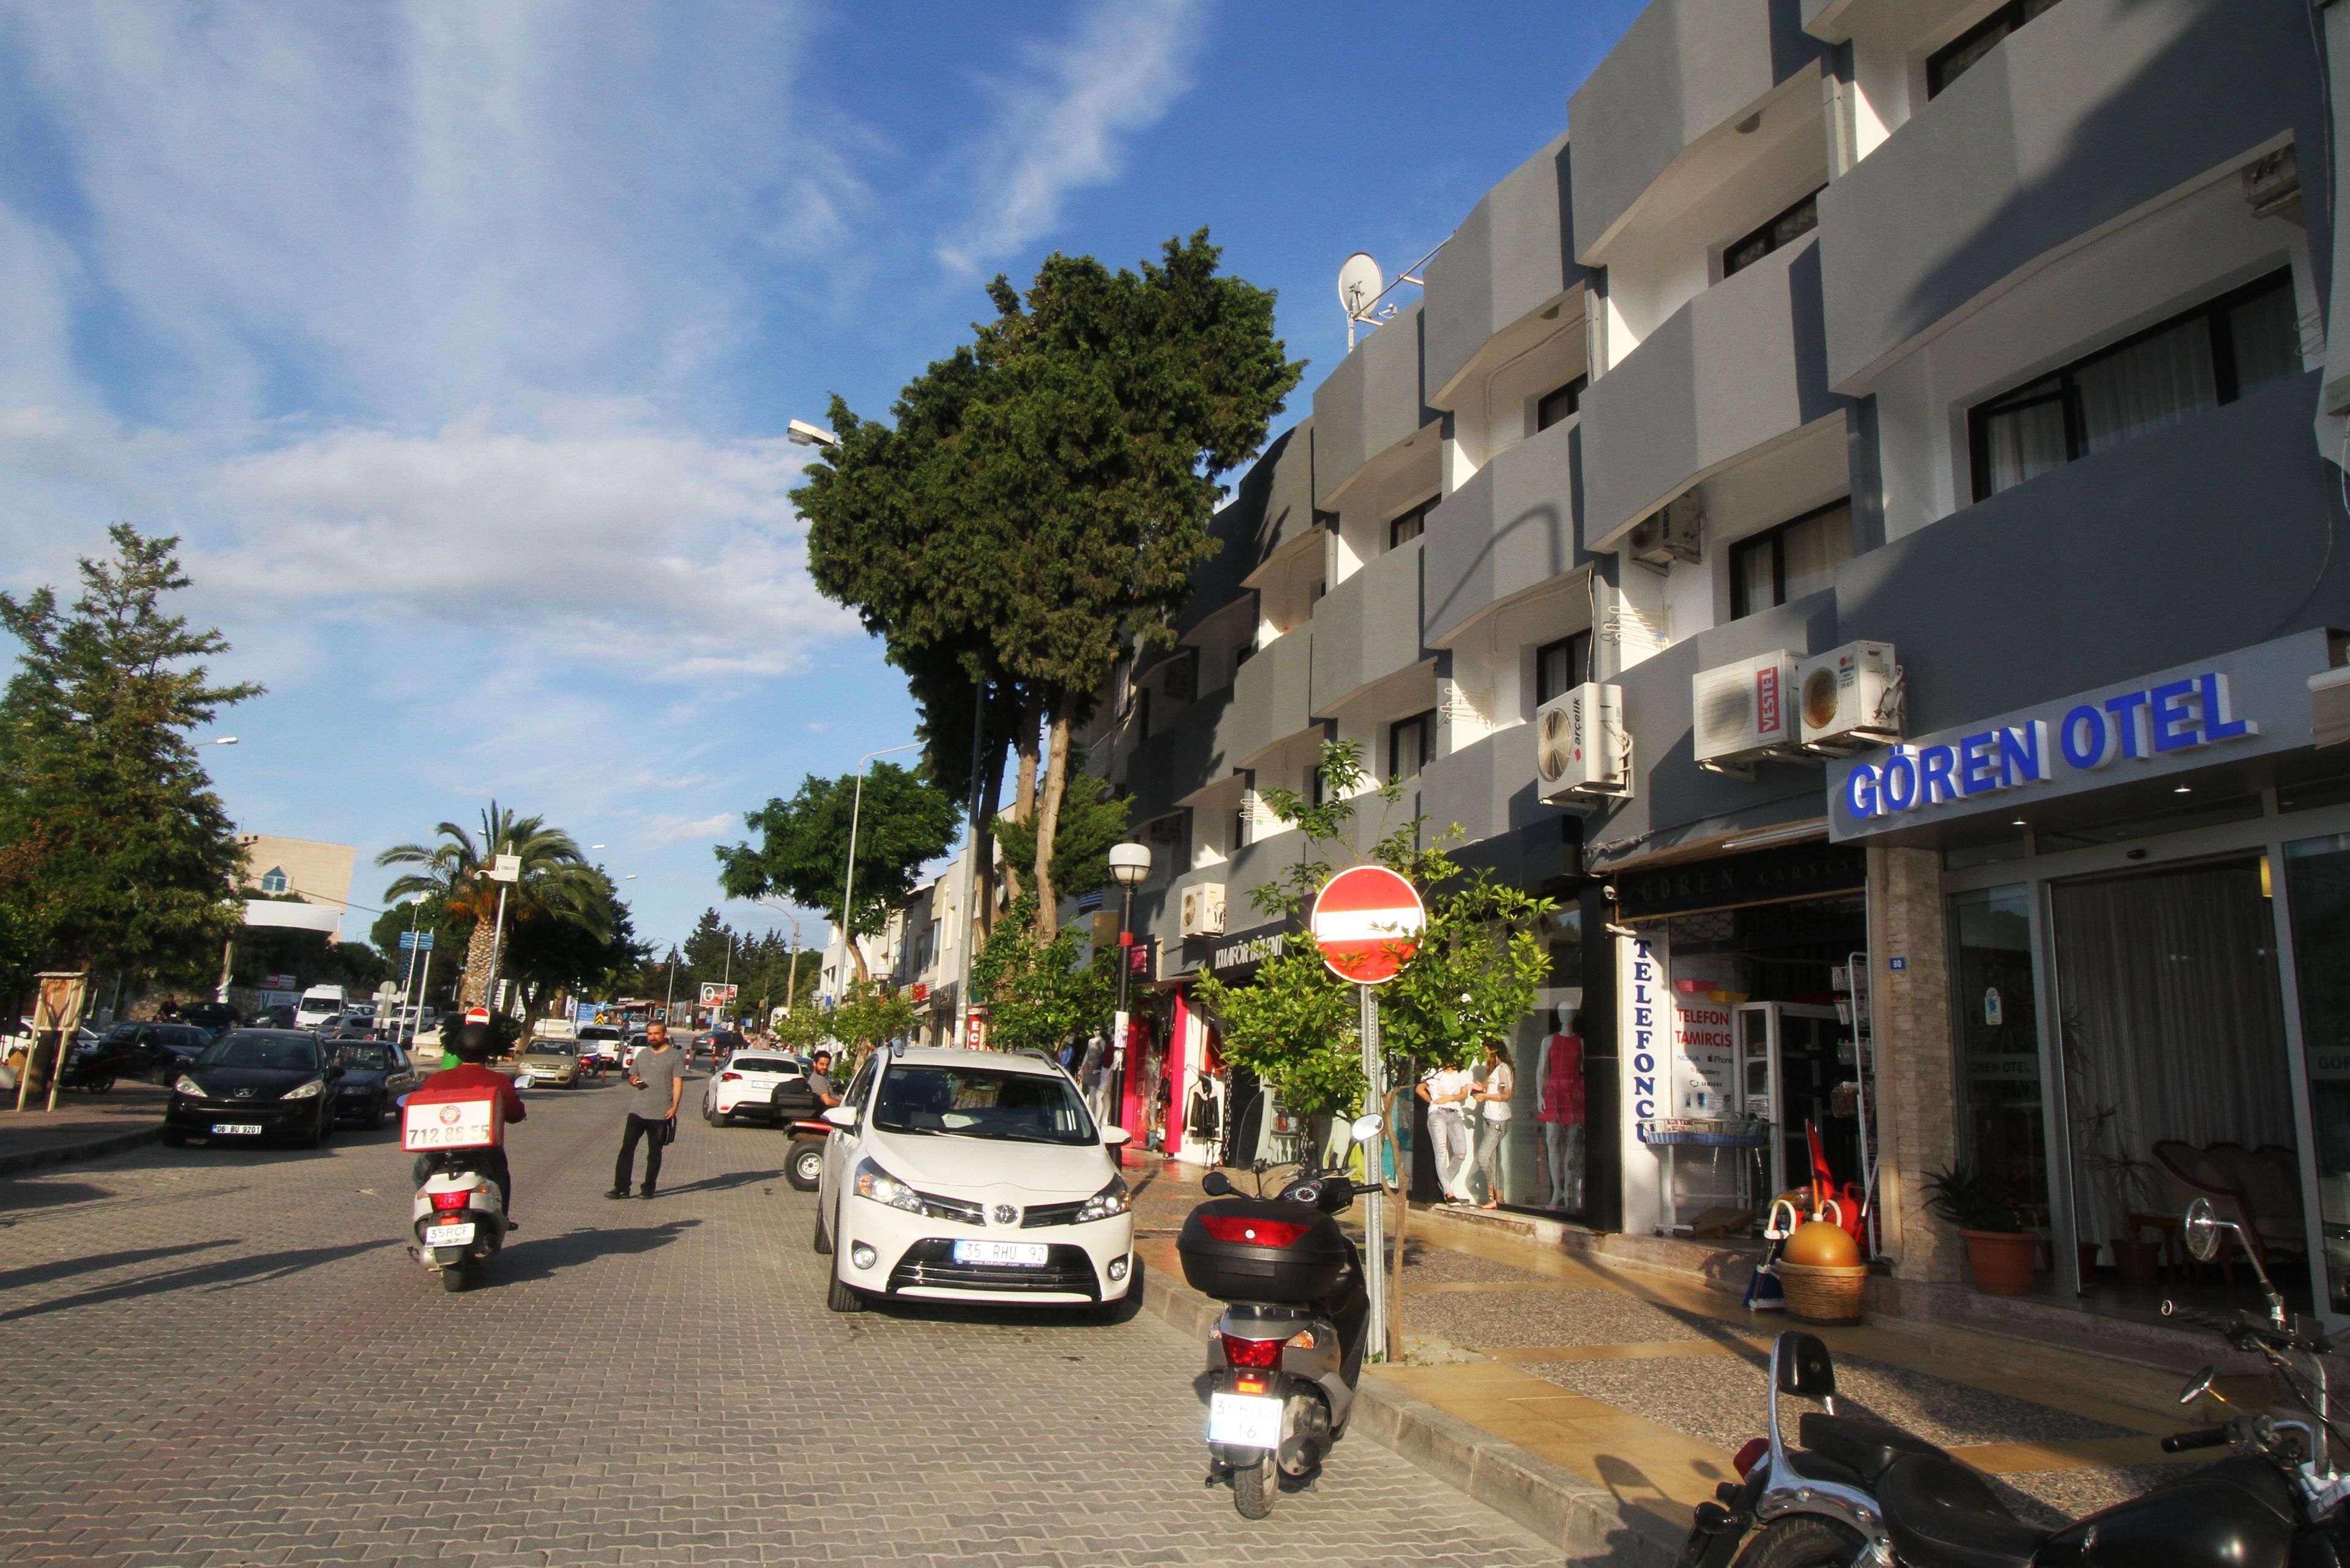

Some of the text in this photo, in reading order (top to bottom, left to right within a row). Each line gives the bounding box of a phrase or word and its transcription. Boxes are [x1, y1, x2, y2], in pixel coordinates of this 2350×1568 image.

[1762, 668, 1775, 732] VESTEL
[1573, 698, 1582, 745] arçelik
[1846, 673, 2257, 820] GÖREN OTEL
[1215, 940, 1248, 969] KUAFÖR
[1677, 1008, 1729, 1026] TELEFON
[1633, 939, 1655, 1143] TELEFONCU
[1714, 1055, 1733, 1064] iPhone
[1696, 1067, 1721, 1076] BlackBerry
[409, 1128, 439, 1144] 712
[431, 1226, 470, 1239] 35RCF
[966, 1244, 1044, 1261] 35 RHU 92
[1239, 1424, 1256, 1439] 16
